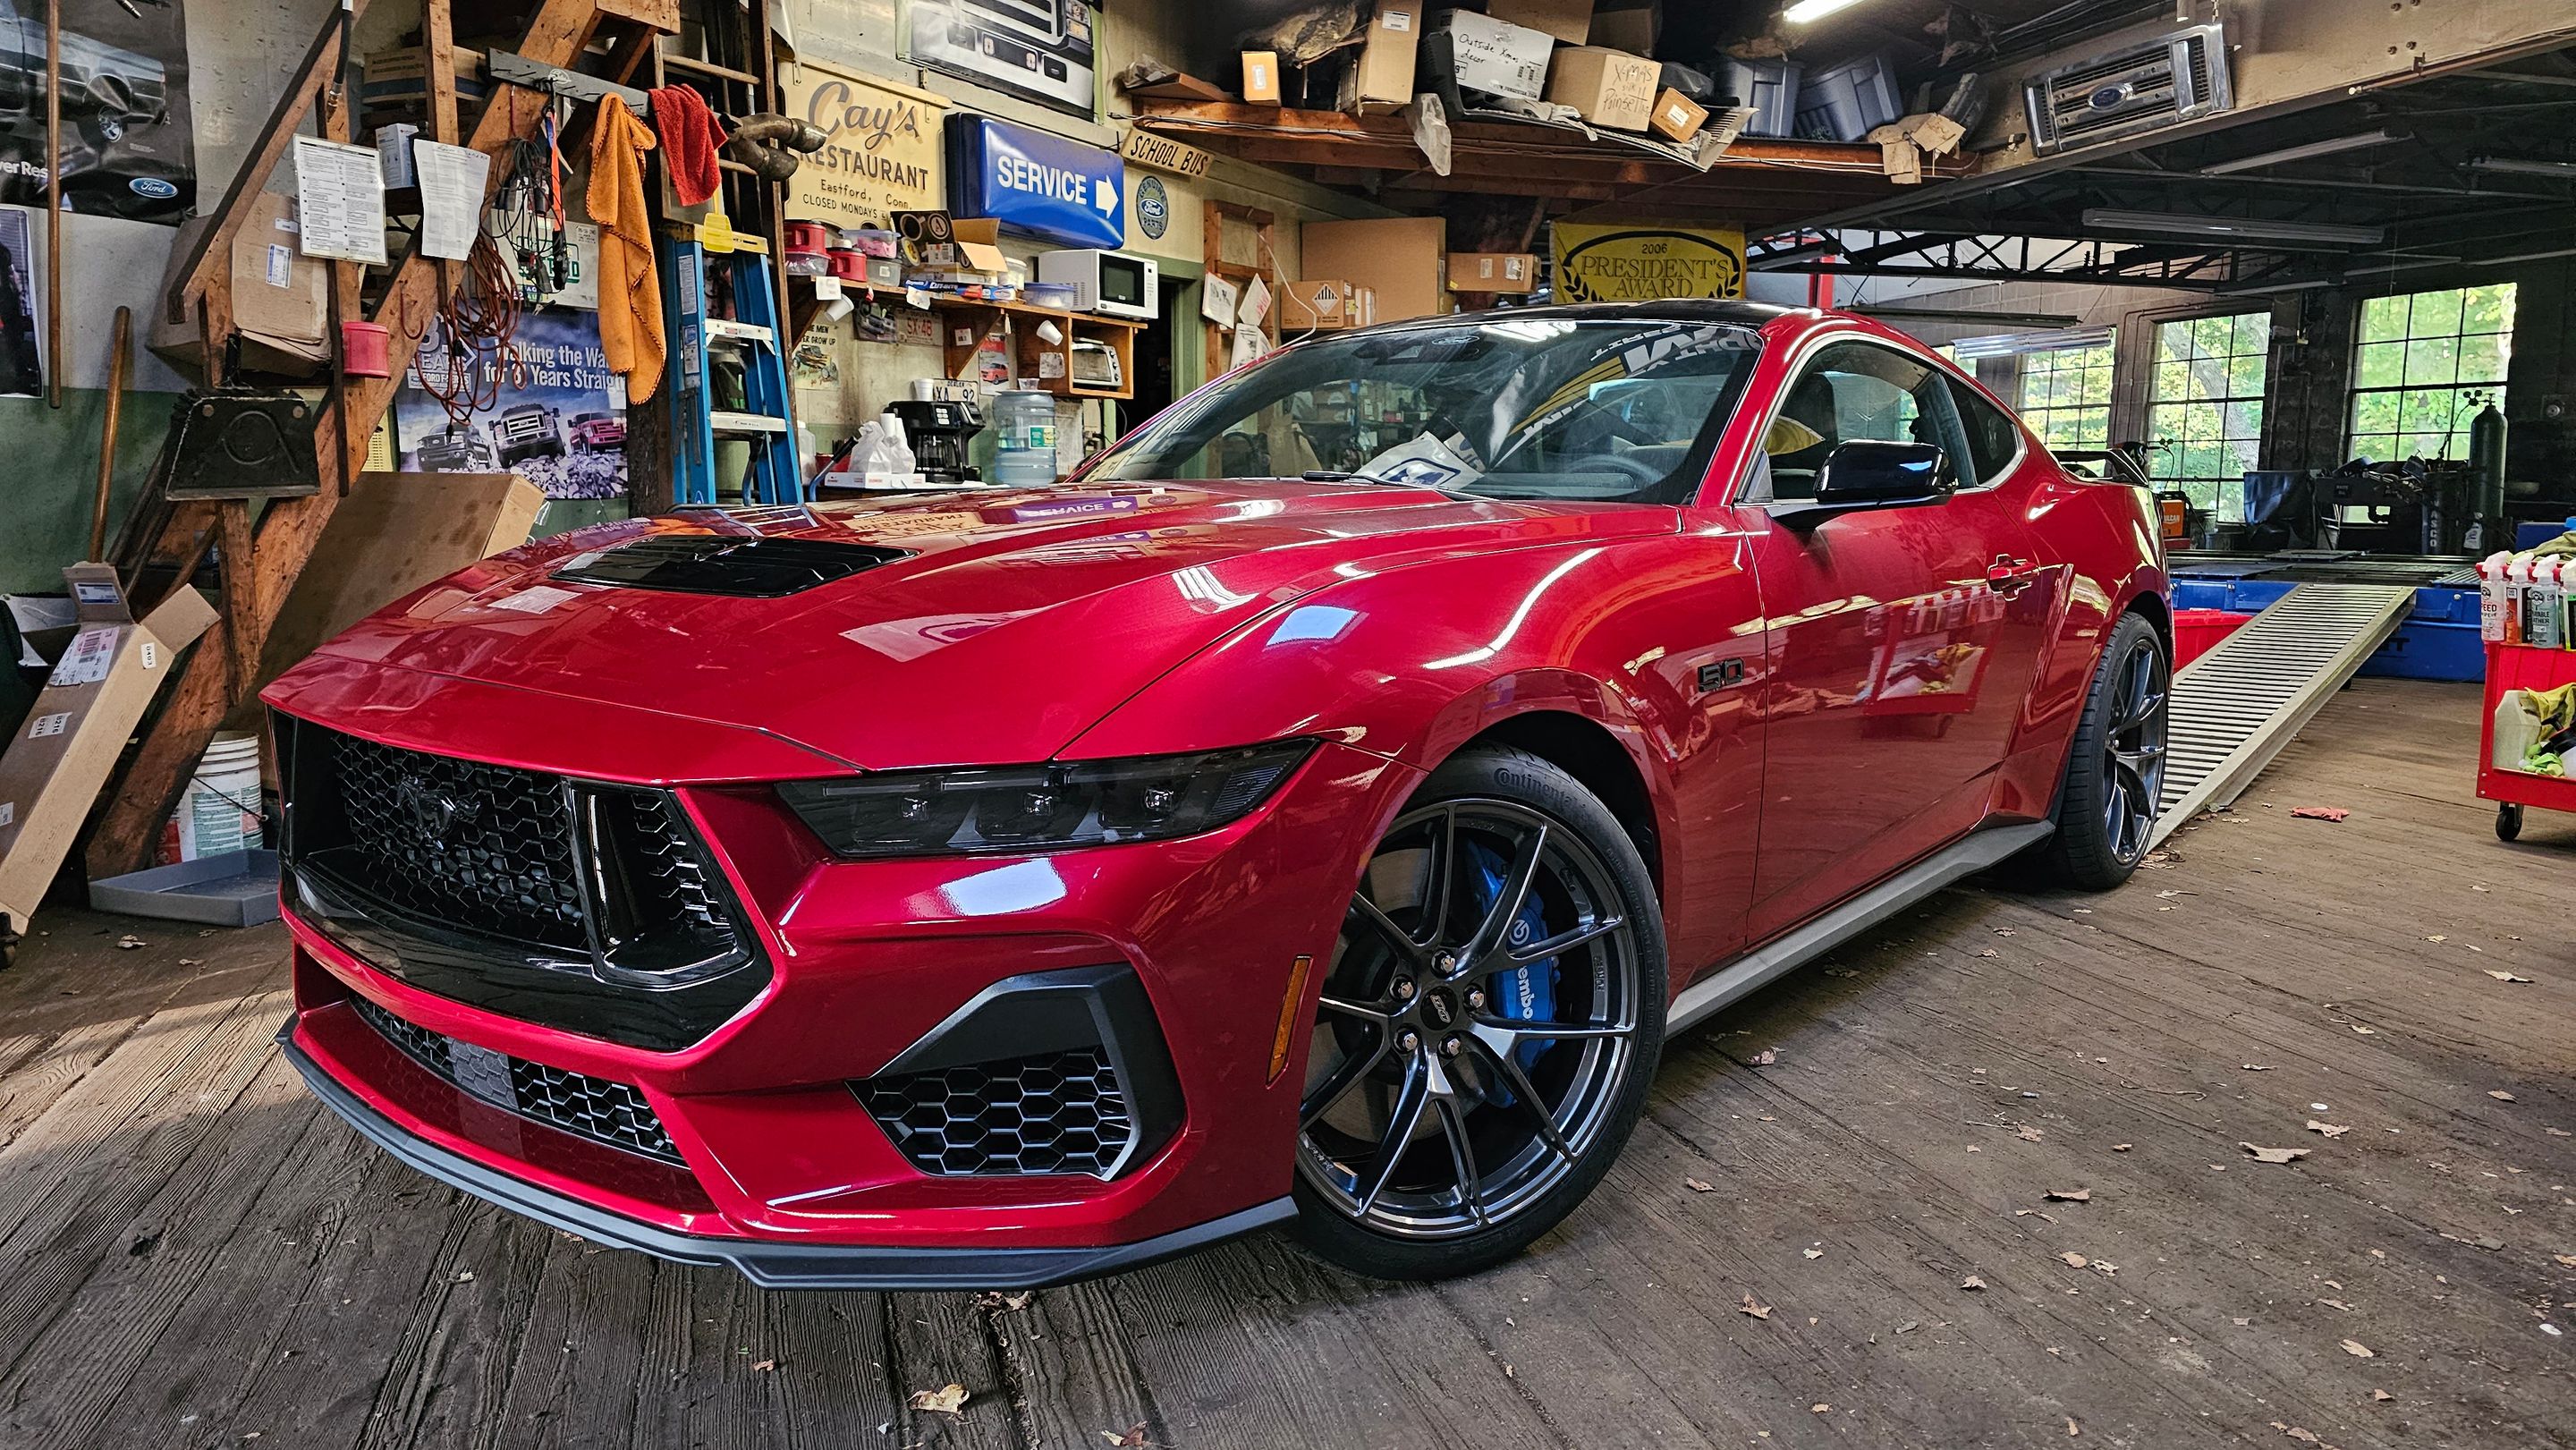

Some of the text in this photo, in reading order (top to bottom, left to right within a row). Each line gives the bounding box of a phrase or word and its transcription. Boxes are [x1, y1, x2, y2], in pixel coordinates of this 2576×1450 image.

[1459, 33, 1495, 54] Outside
[1461, 49, 1486, 64] decor
[808, 81, 919, 150] Cay's
[1131, 135, 1208, 175] SCHOOL BUS
[140, 181, 166, 194] Ford
[997, 156, 1088, 206] SERVICE
[802, 193, 837, 209] CLOSED
[841, 202, 877, 219] MONDAYS
[821, 179, 912, 210] Eastford, Conn.
[1641, 243, 1668, 254] 2006
[1580, 255, 1729, 279] PRESIDENT'S
[1612, 278, 1693, 298] AWARD
[816, 325, 829, 334] MEN
[558, 344, 581, 366] the
[530, 364, 571, 388] Years
